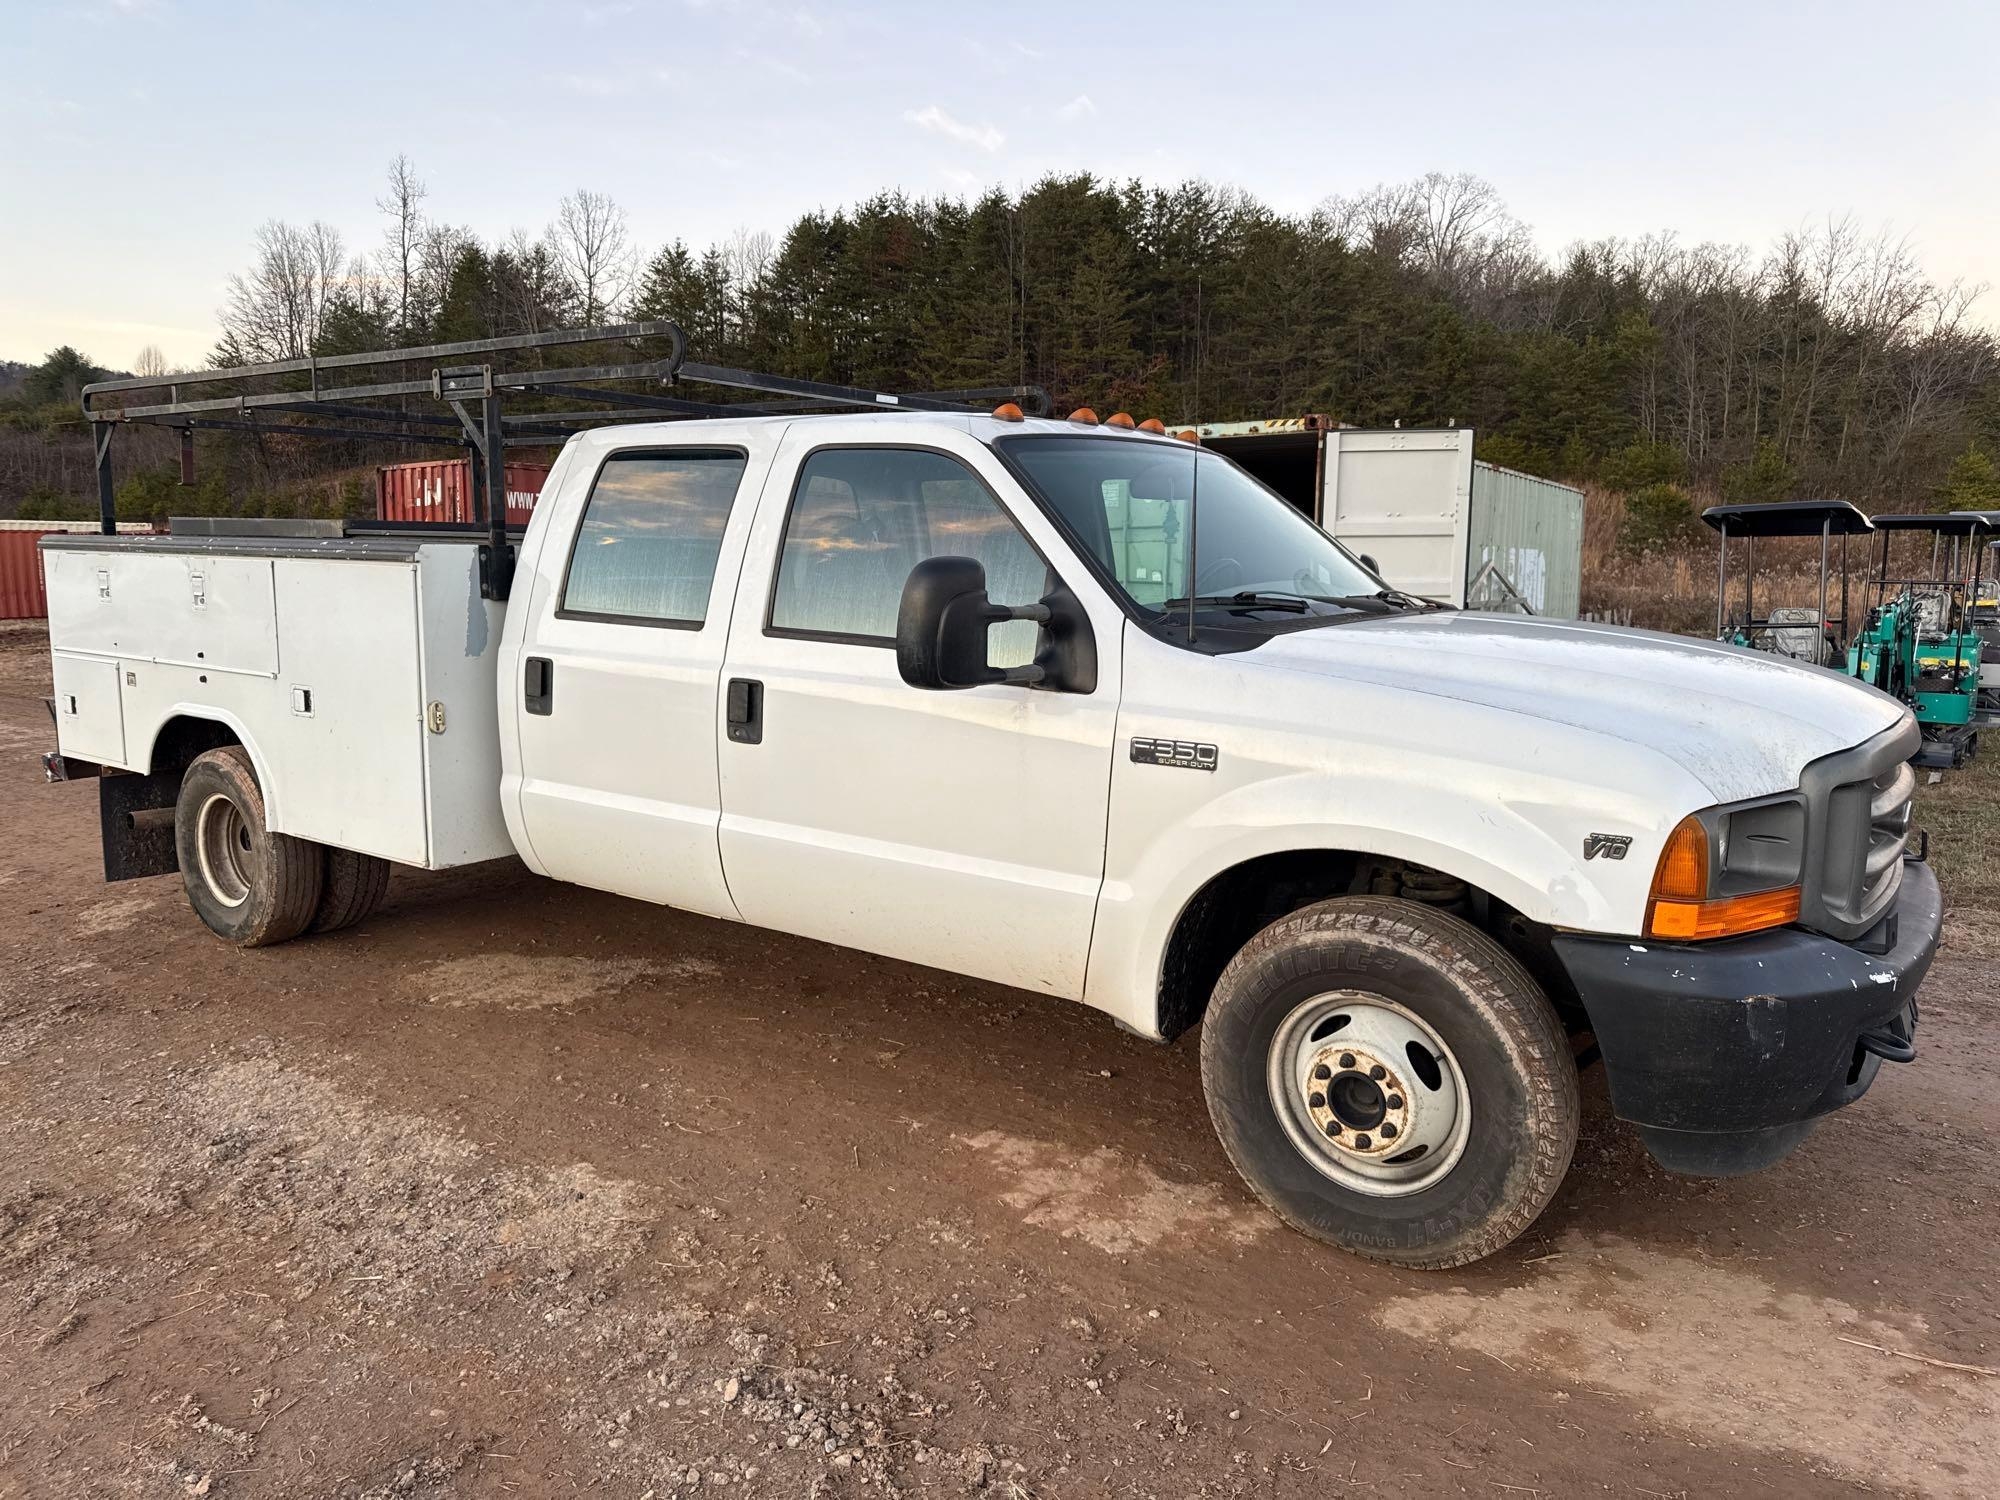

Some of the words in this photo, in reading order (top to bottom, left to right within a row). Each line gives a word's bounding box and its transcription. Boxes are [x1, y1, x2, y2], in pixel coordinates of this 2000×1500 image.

[1131, 738, 1217, 763] F-350
[1158, 757, 1188, 767] SUPER
[1190, 761, 1215, 769] DUTY
[1584, 838, 1627, 860] V10
[1232, 945, 1373, 1025] DELINTE
[1338, 1229, 1396, 1248] BANDIT
